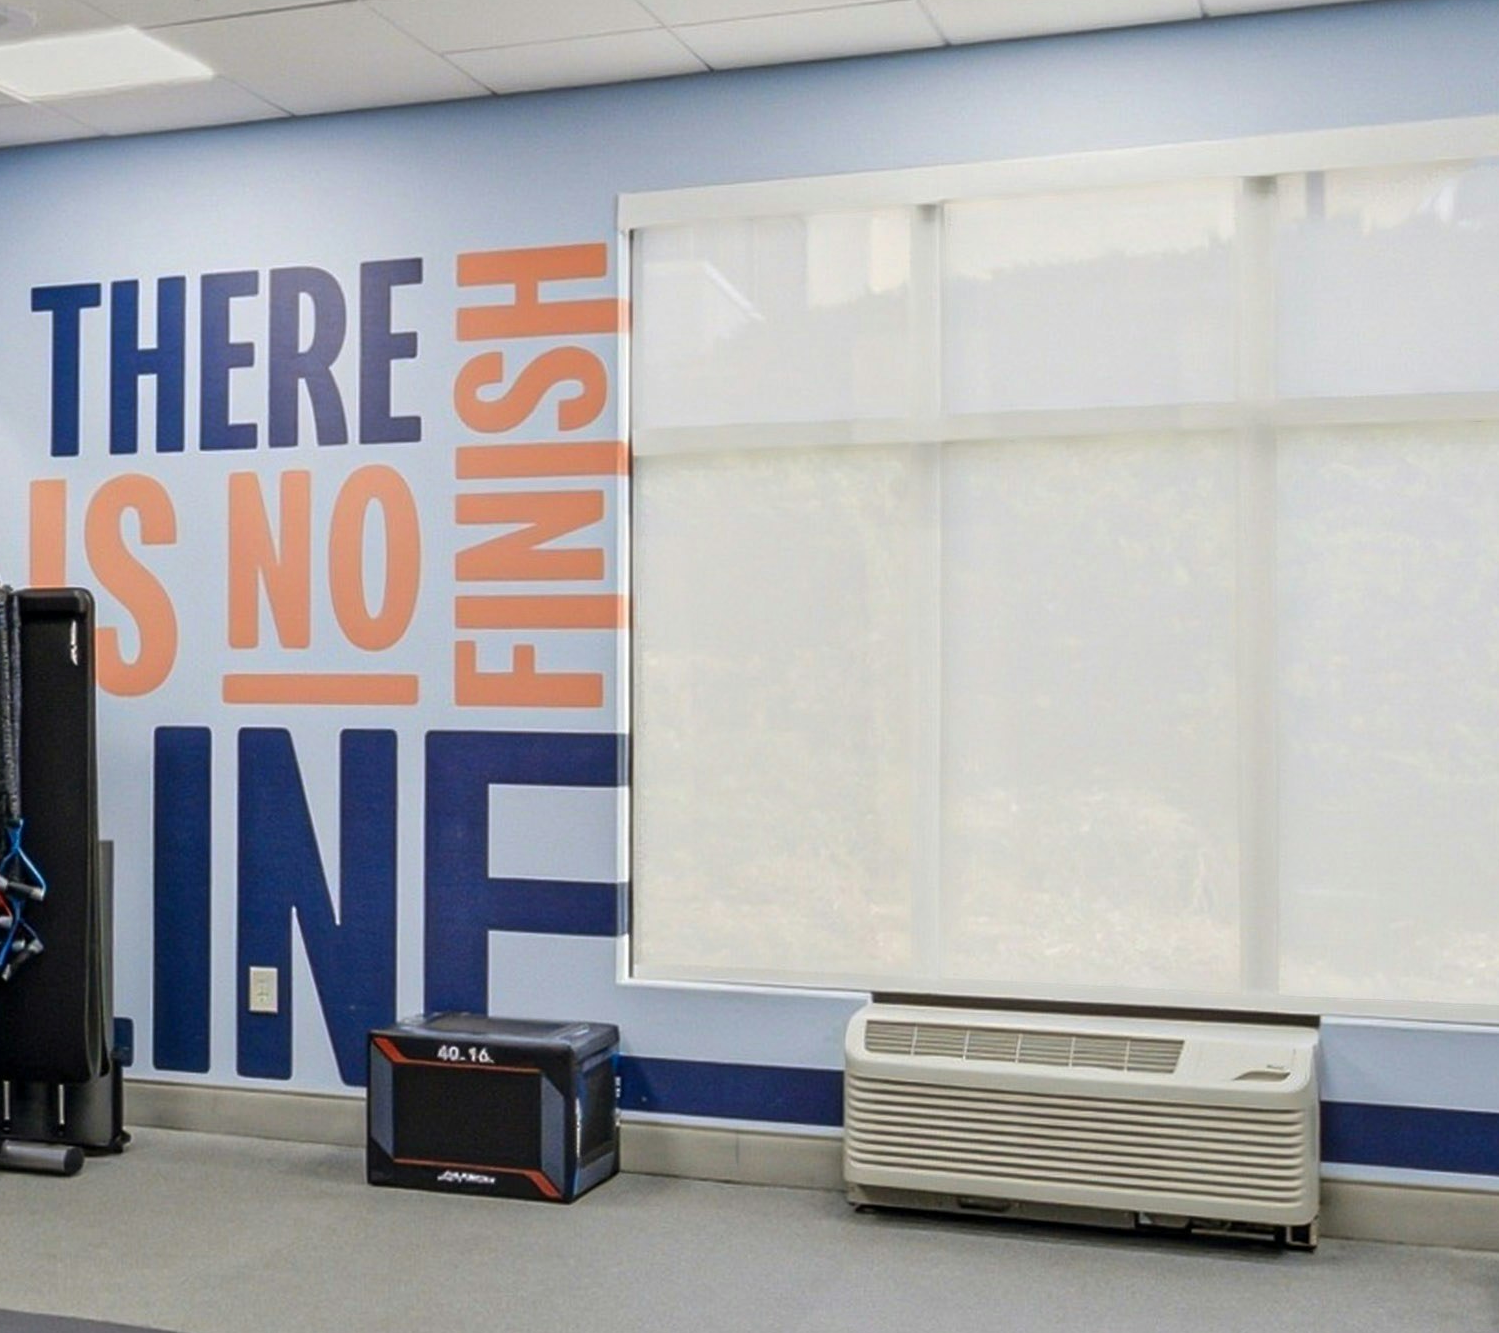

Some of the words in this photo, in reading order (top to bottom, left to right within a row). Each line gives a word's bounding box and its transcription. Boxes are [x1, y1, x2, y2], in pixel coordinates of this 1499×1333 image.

[30, 256, 423, 458] THERE
[453, 242, 629, 708] FINISH
[28, 471, 178, 698] IS
[226, 464, 421, 652] NO
[113, 725, 630, 1088] INE
